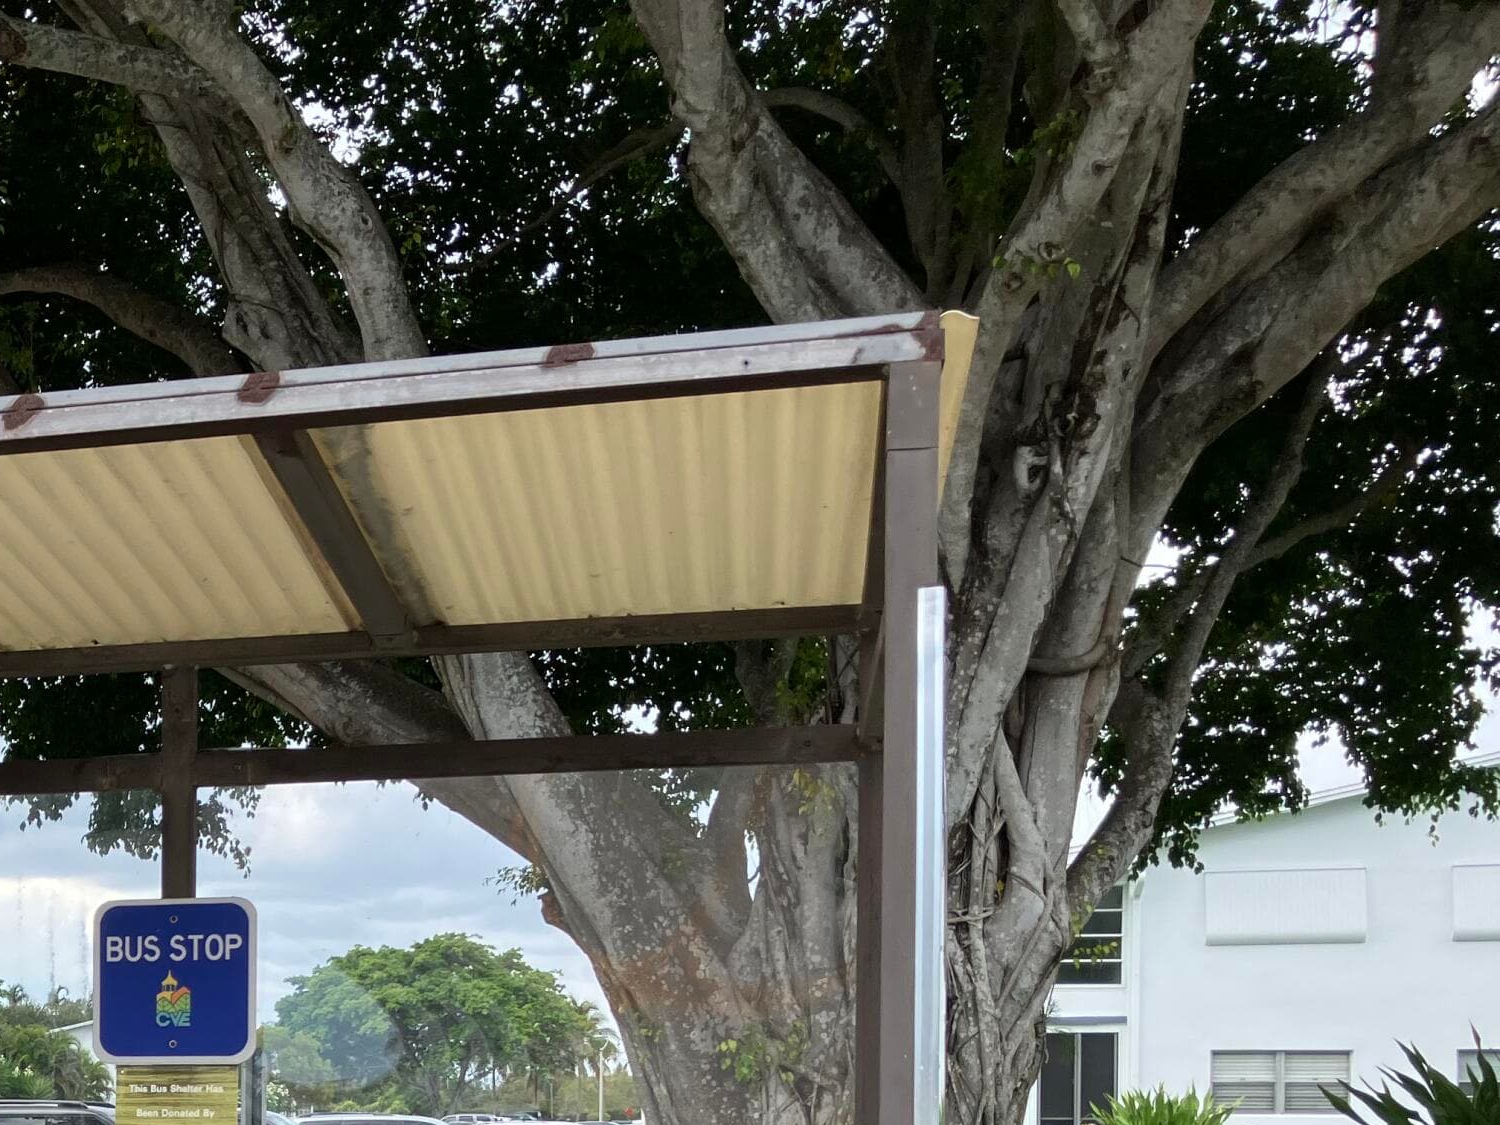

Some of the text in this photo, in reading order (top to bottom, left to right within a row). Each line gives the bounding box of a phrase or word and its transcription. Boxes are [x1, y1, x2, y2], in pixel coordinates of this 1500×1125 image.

[105, 933, 243, 963] BUS STOP
[156, 1011, 191, 1027] CVE
[129, 1084, 224, 1093] This Bus Shelter Has
[136, 1108, 215, 1119] Been Donated By
